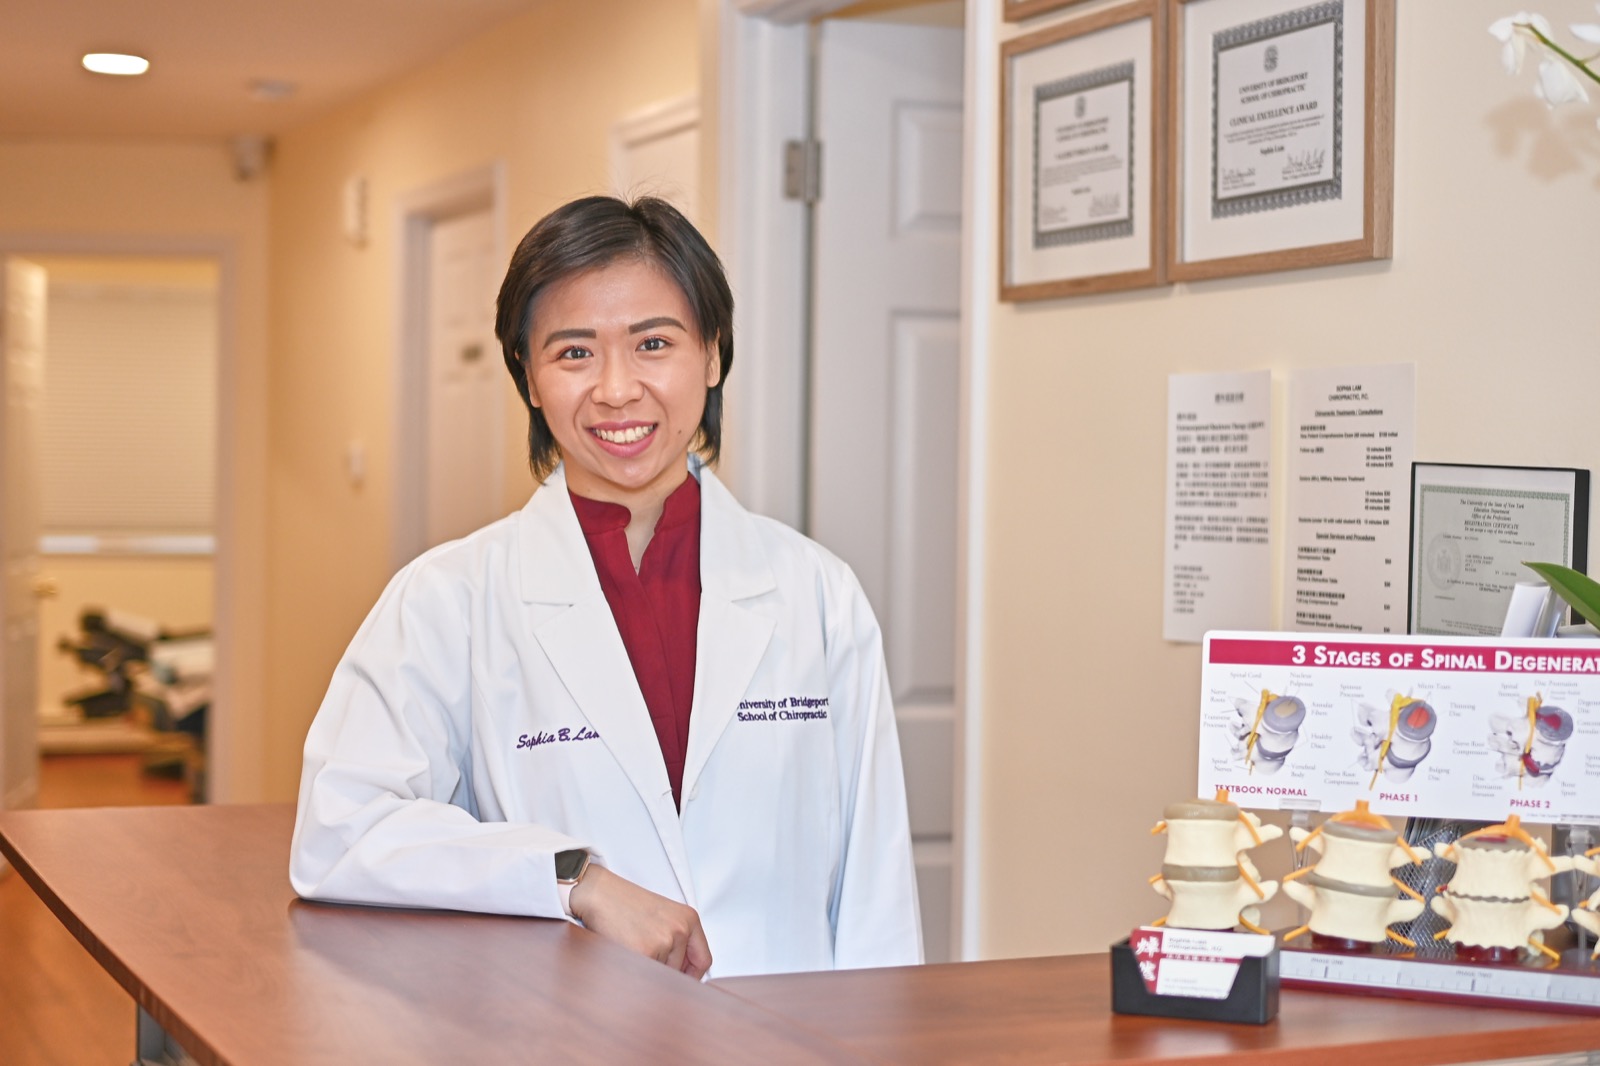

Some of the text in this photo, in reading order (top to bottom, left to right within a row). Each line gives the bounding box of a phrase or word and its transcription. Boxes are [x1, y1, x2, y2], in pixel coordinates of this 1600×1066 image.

[1229, 101, 1318, 127] CLINICAL EXCELLENCE AWARD
[1467, 499, 1483, 507] University
[1493, 514, 1512, 522] Professions
[1464, 520, 1519, 530] REGISTRATION CERTIFICATE
[1330, 533, 1345, 541] Services
[1354, 533, 1376, 542] Procedures
[1292, 645, 1306, 665] 3
[1230, 672, 1246, 680] Spinal
[737, 696, 829, 711] niversity of Bridgeport
[737, 708, 828, 722] School of Chiropractic
[516, 730, 556, 751] Sophia
[1311, 733, 1333, 742] Healthy
[1214, 765, 1232, 773] Nerves
[1428, 767, 1450, 775] Bulging
[1291, 771, 1305, 779] Body
[1324, 778, 1360, 786] Compression
[1215, 784, 1308, 797] TEXTBOOK NORMAL
[1379, 792, 1418, 802] PHASE 1
[1510, 799, 1551, 809] PHASE 2
